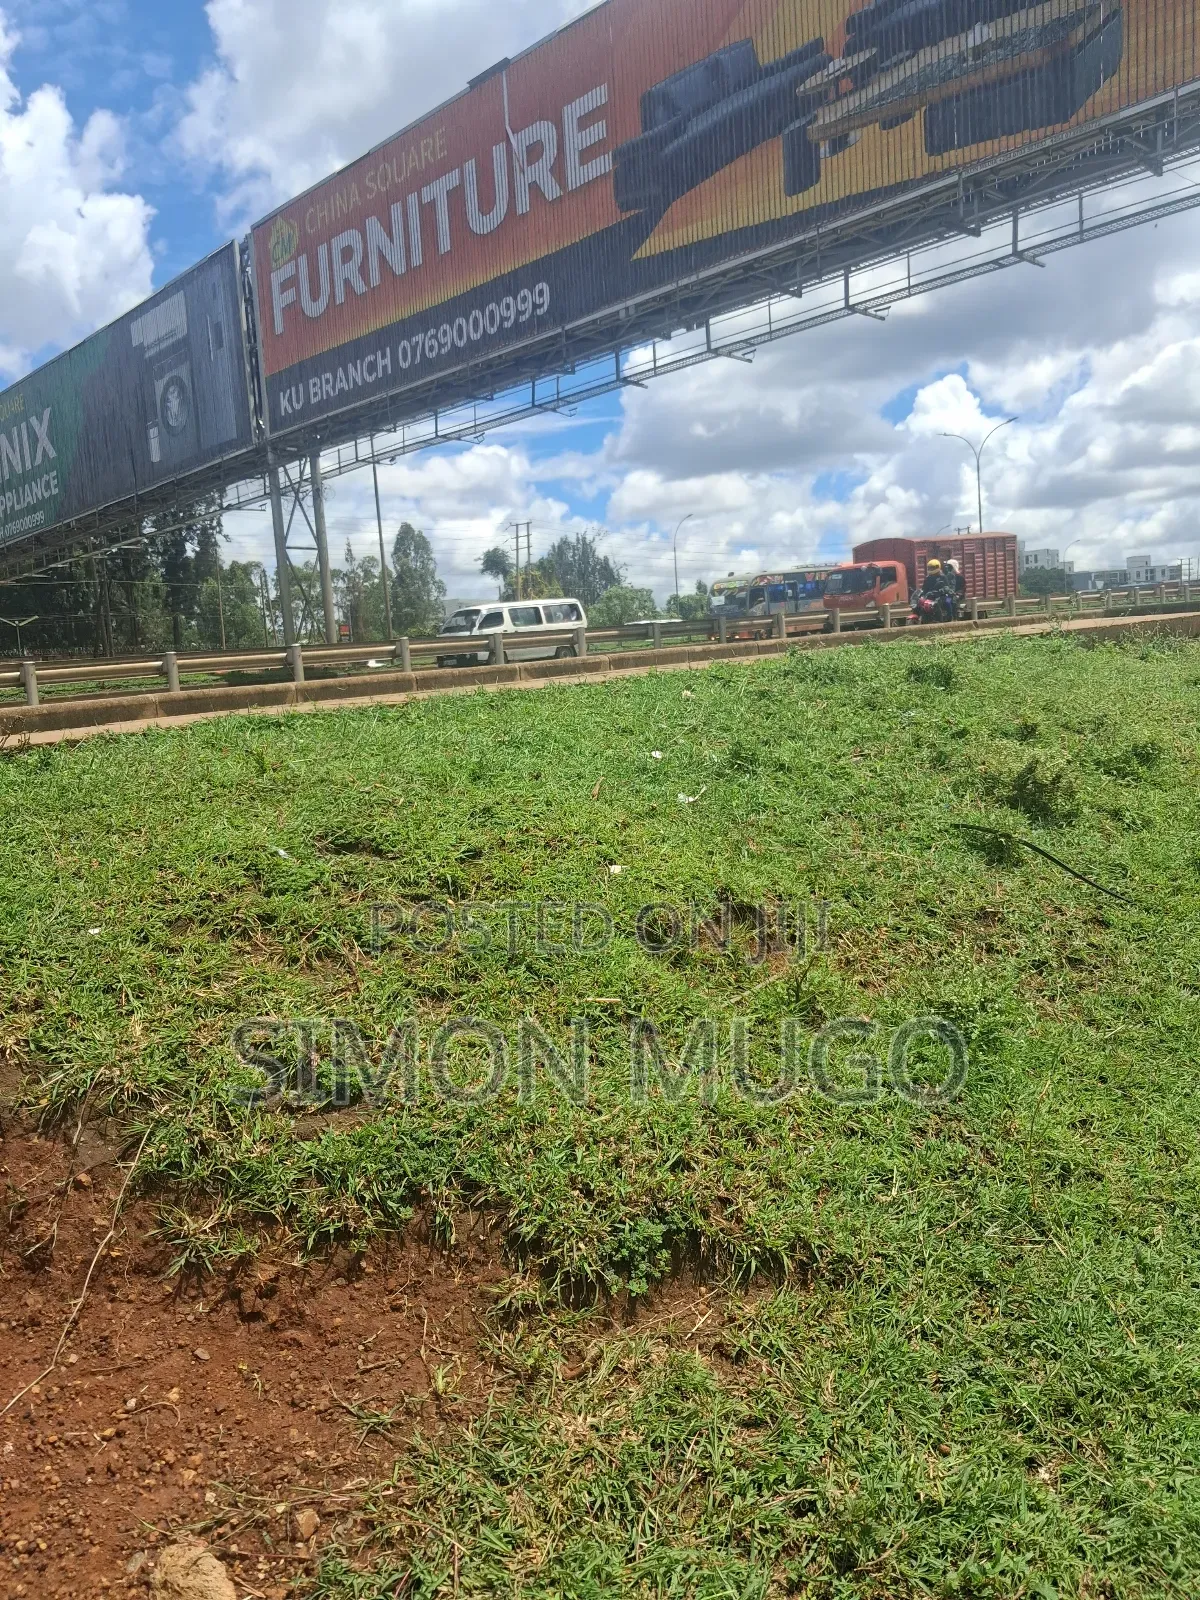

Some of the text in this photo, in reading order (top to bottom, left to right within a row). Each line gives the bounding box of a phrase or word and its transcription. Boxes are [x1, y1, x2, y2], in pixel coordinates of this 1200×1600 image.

[270, 82, 613, 336] FURNITURE
[304, 126, 448, 234] CHINA SQUARE
[279, 282, 551, 417] KU BRANCH 0769000999
[0, 406, 57, 484] NIX
[5, 510, 45, 537] 0769000999
